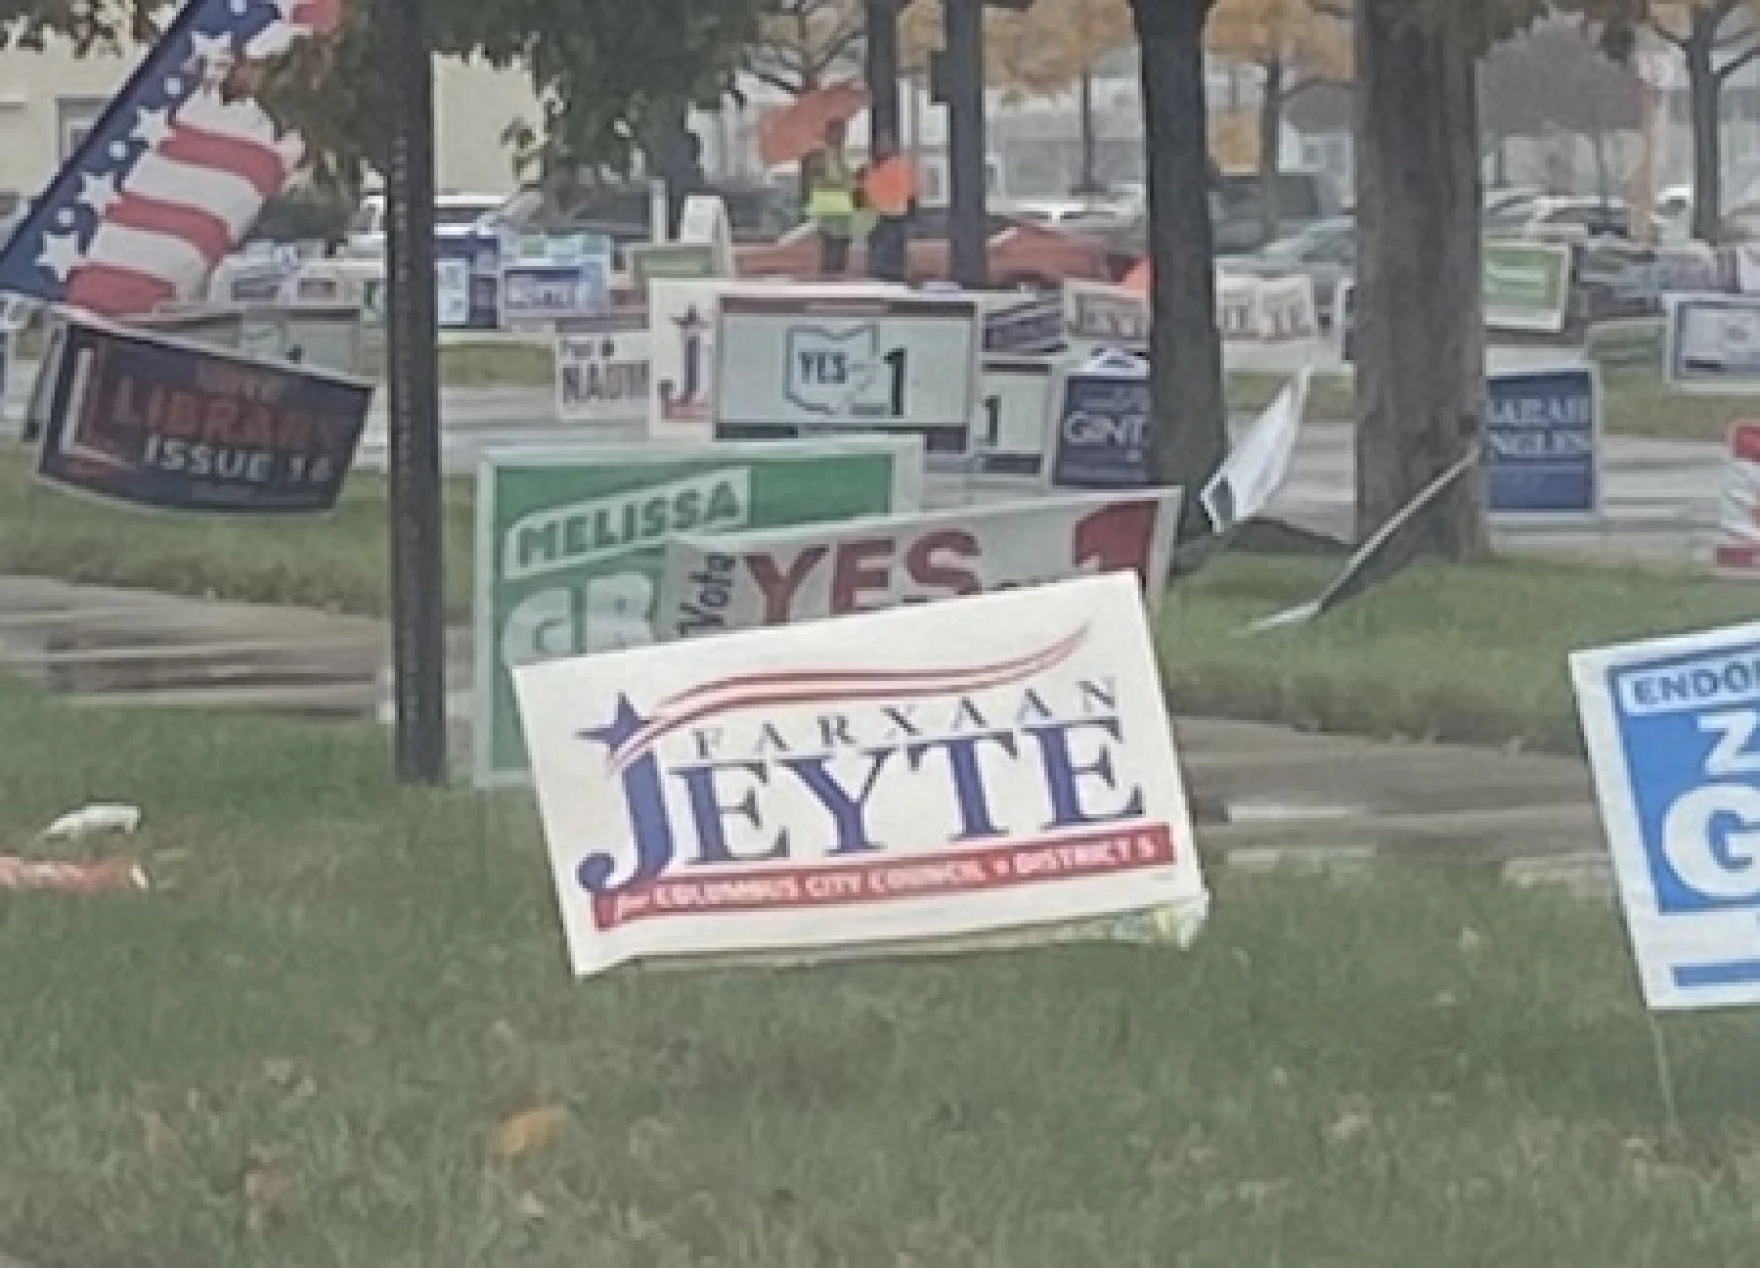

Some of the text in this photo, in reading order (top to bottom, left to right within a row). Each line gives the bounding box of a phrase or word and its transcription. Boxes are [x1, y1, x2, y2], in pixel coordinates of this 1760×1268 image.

[798, 350, 848, 386] YES
[142, 434, 273, 482] ISSUE
[519, 480, 740, 568] MELISSA
[676, 552, 737, 640] Vote
[746, 527, 983, 627] YES
[692, 676, 1120, 758] FARXAAN
[1632, 655, 1760, 706] ENDO
[575, 716, 1147, 894] JEYTE
[654, 875, 799, 907] COLUMBUS
[805, 870, 862, 899] CITY
[868, 858, 988, 894] COUNCIL
[1013, 836, 1133, 875] DISTRICT
